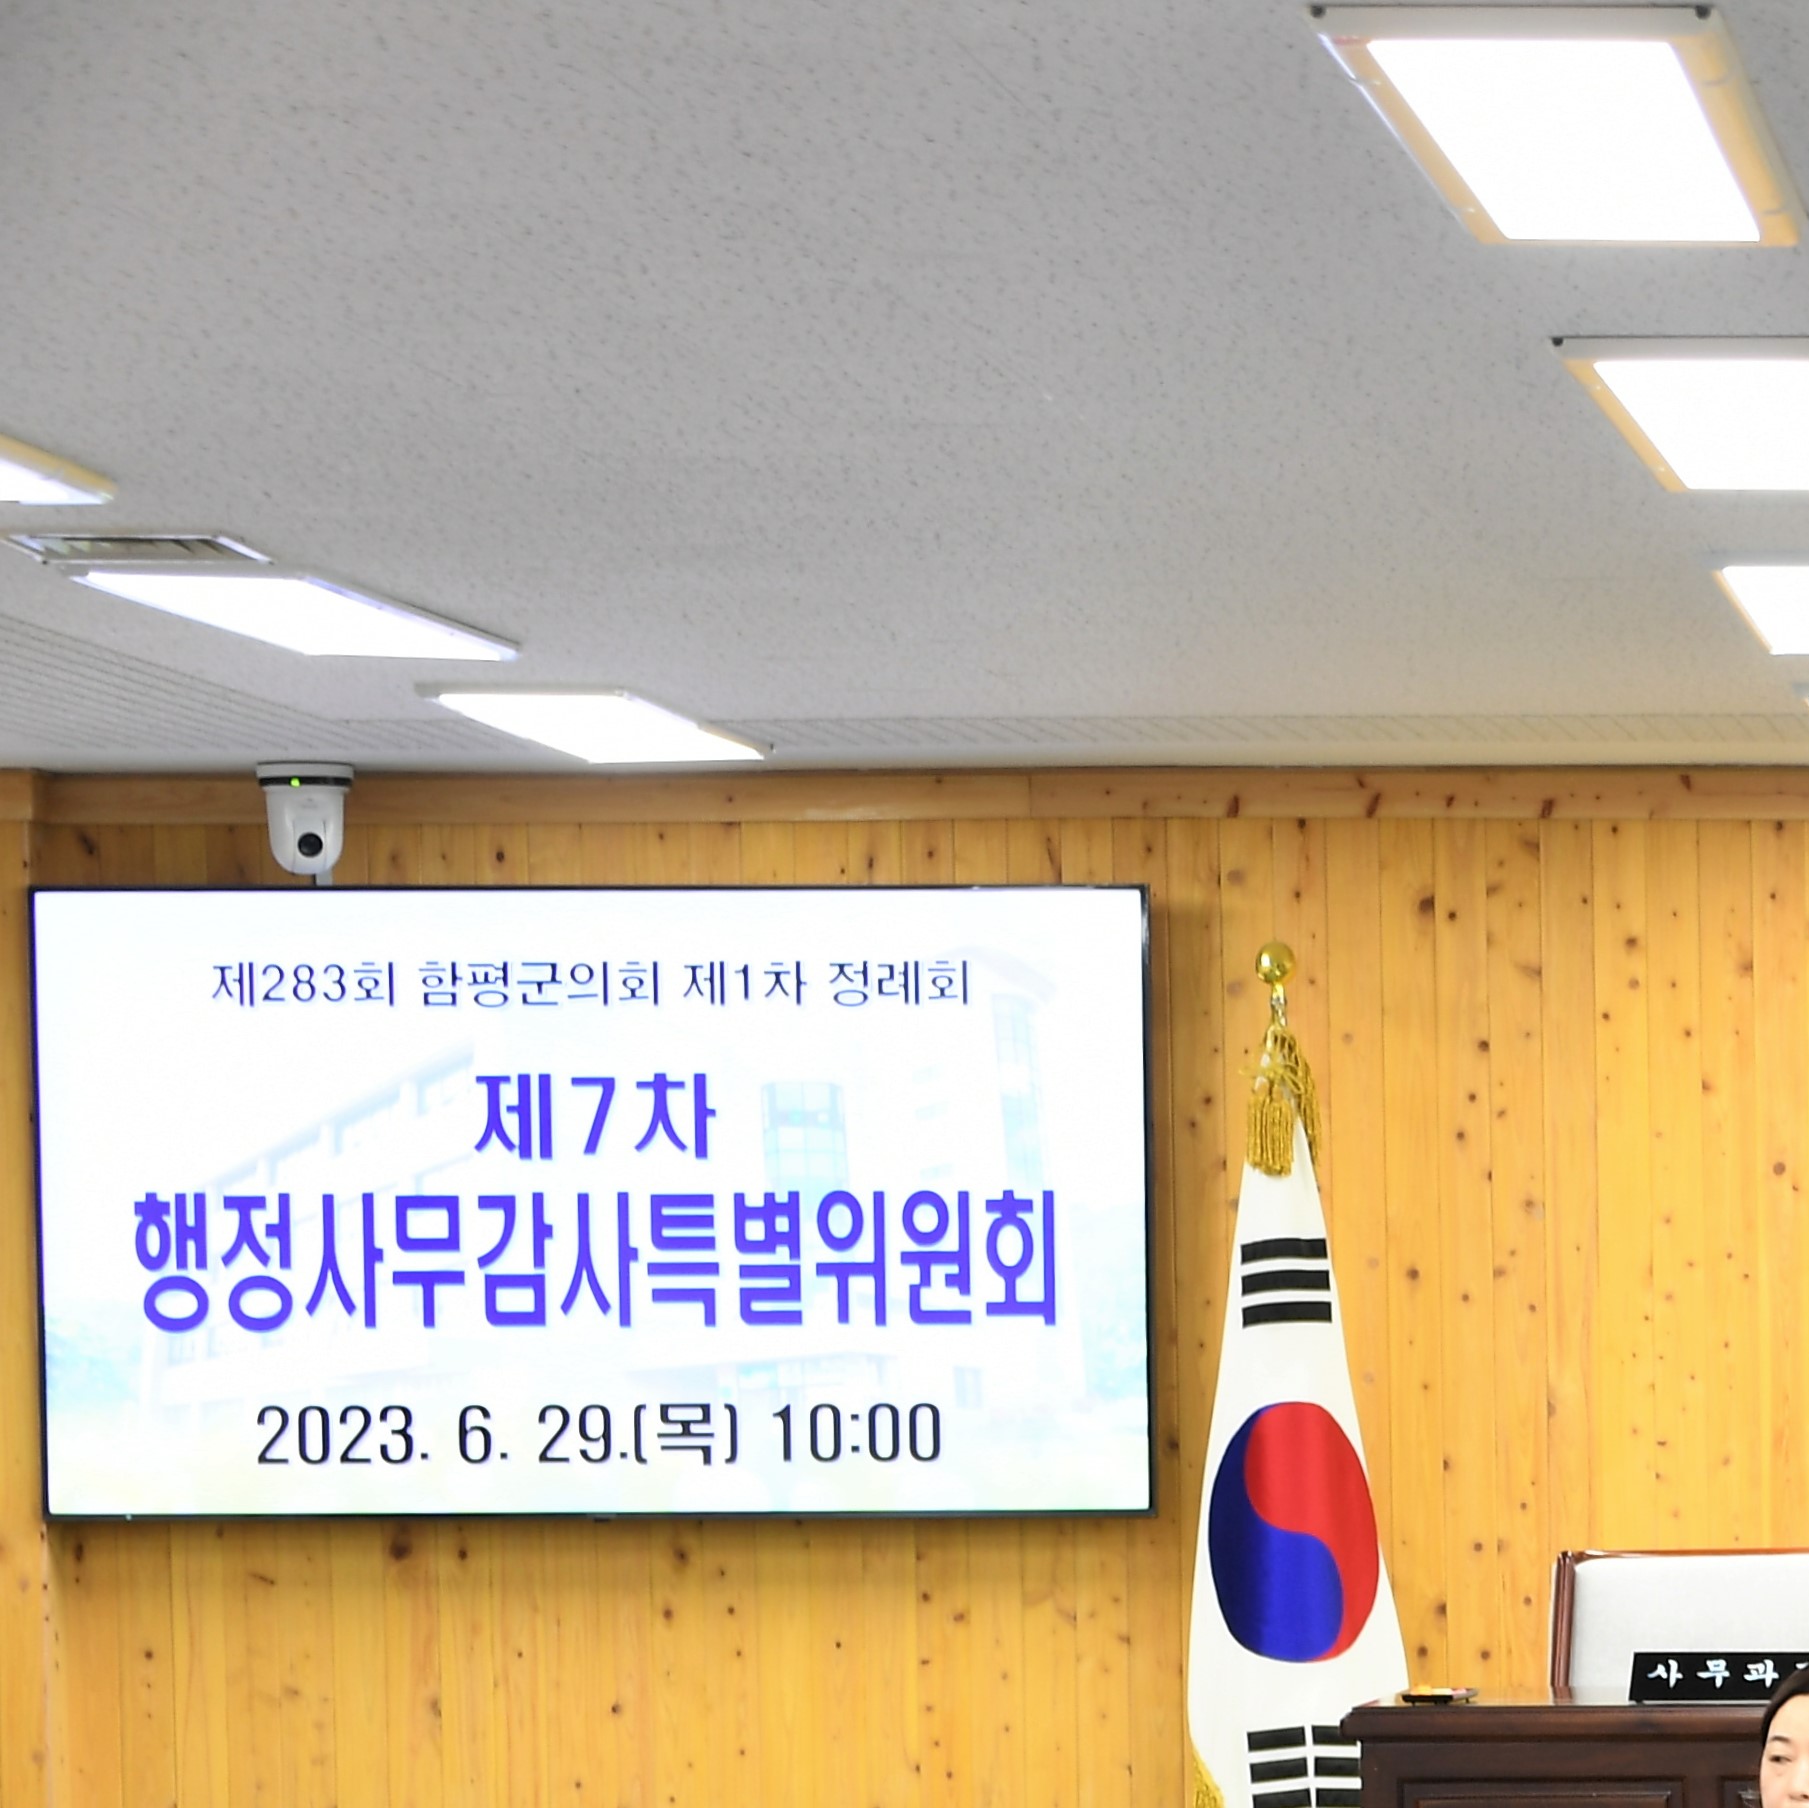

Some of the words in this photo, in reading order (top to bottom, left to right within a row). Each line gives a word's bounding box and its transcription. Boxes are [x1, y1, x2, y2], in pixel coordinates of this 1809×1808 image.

[213, 962, 394, 1007] 제283회
[419, 961, 658, 1008] 함평군의회
[684, 961, 807, 1006] 제1차
[830, 960, 967, 1007] 정례회
[475, 1073, 716, 1159] 제7차
[135, 1190, 1055, 1332] 행정사무감사특별위원회
[257, 1405, 428, 1464] 2023.
[459, 1405, 507, 1464] 6.
[773, 1403, 940, 1462] 10:00
[1646, 1658, 1808, 1689] 사무과
